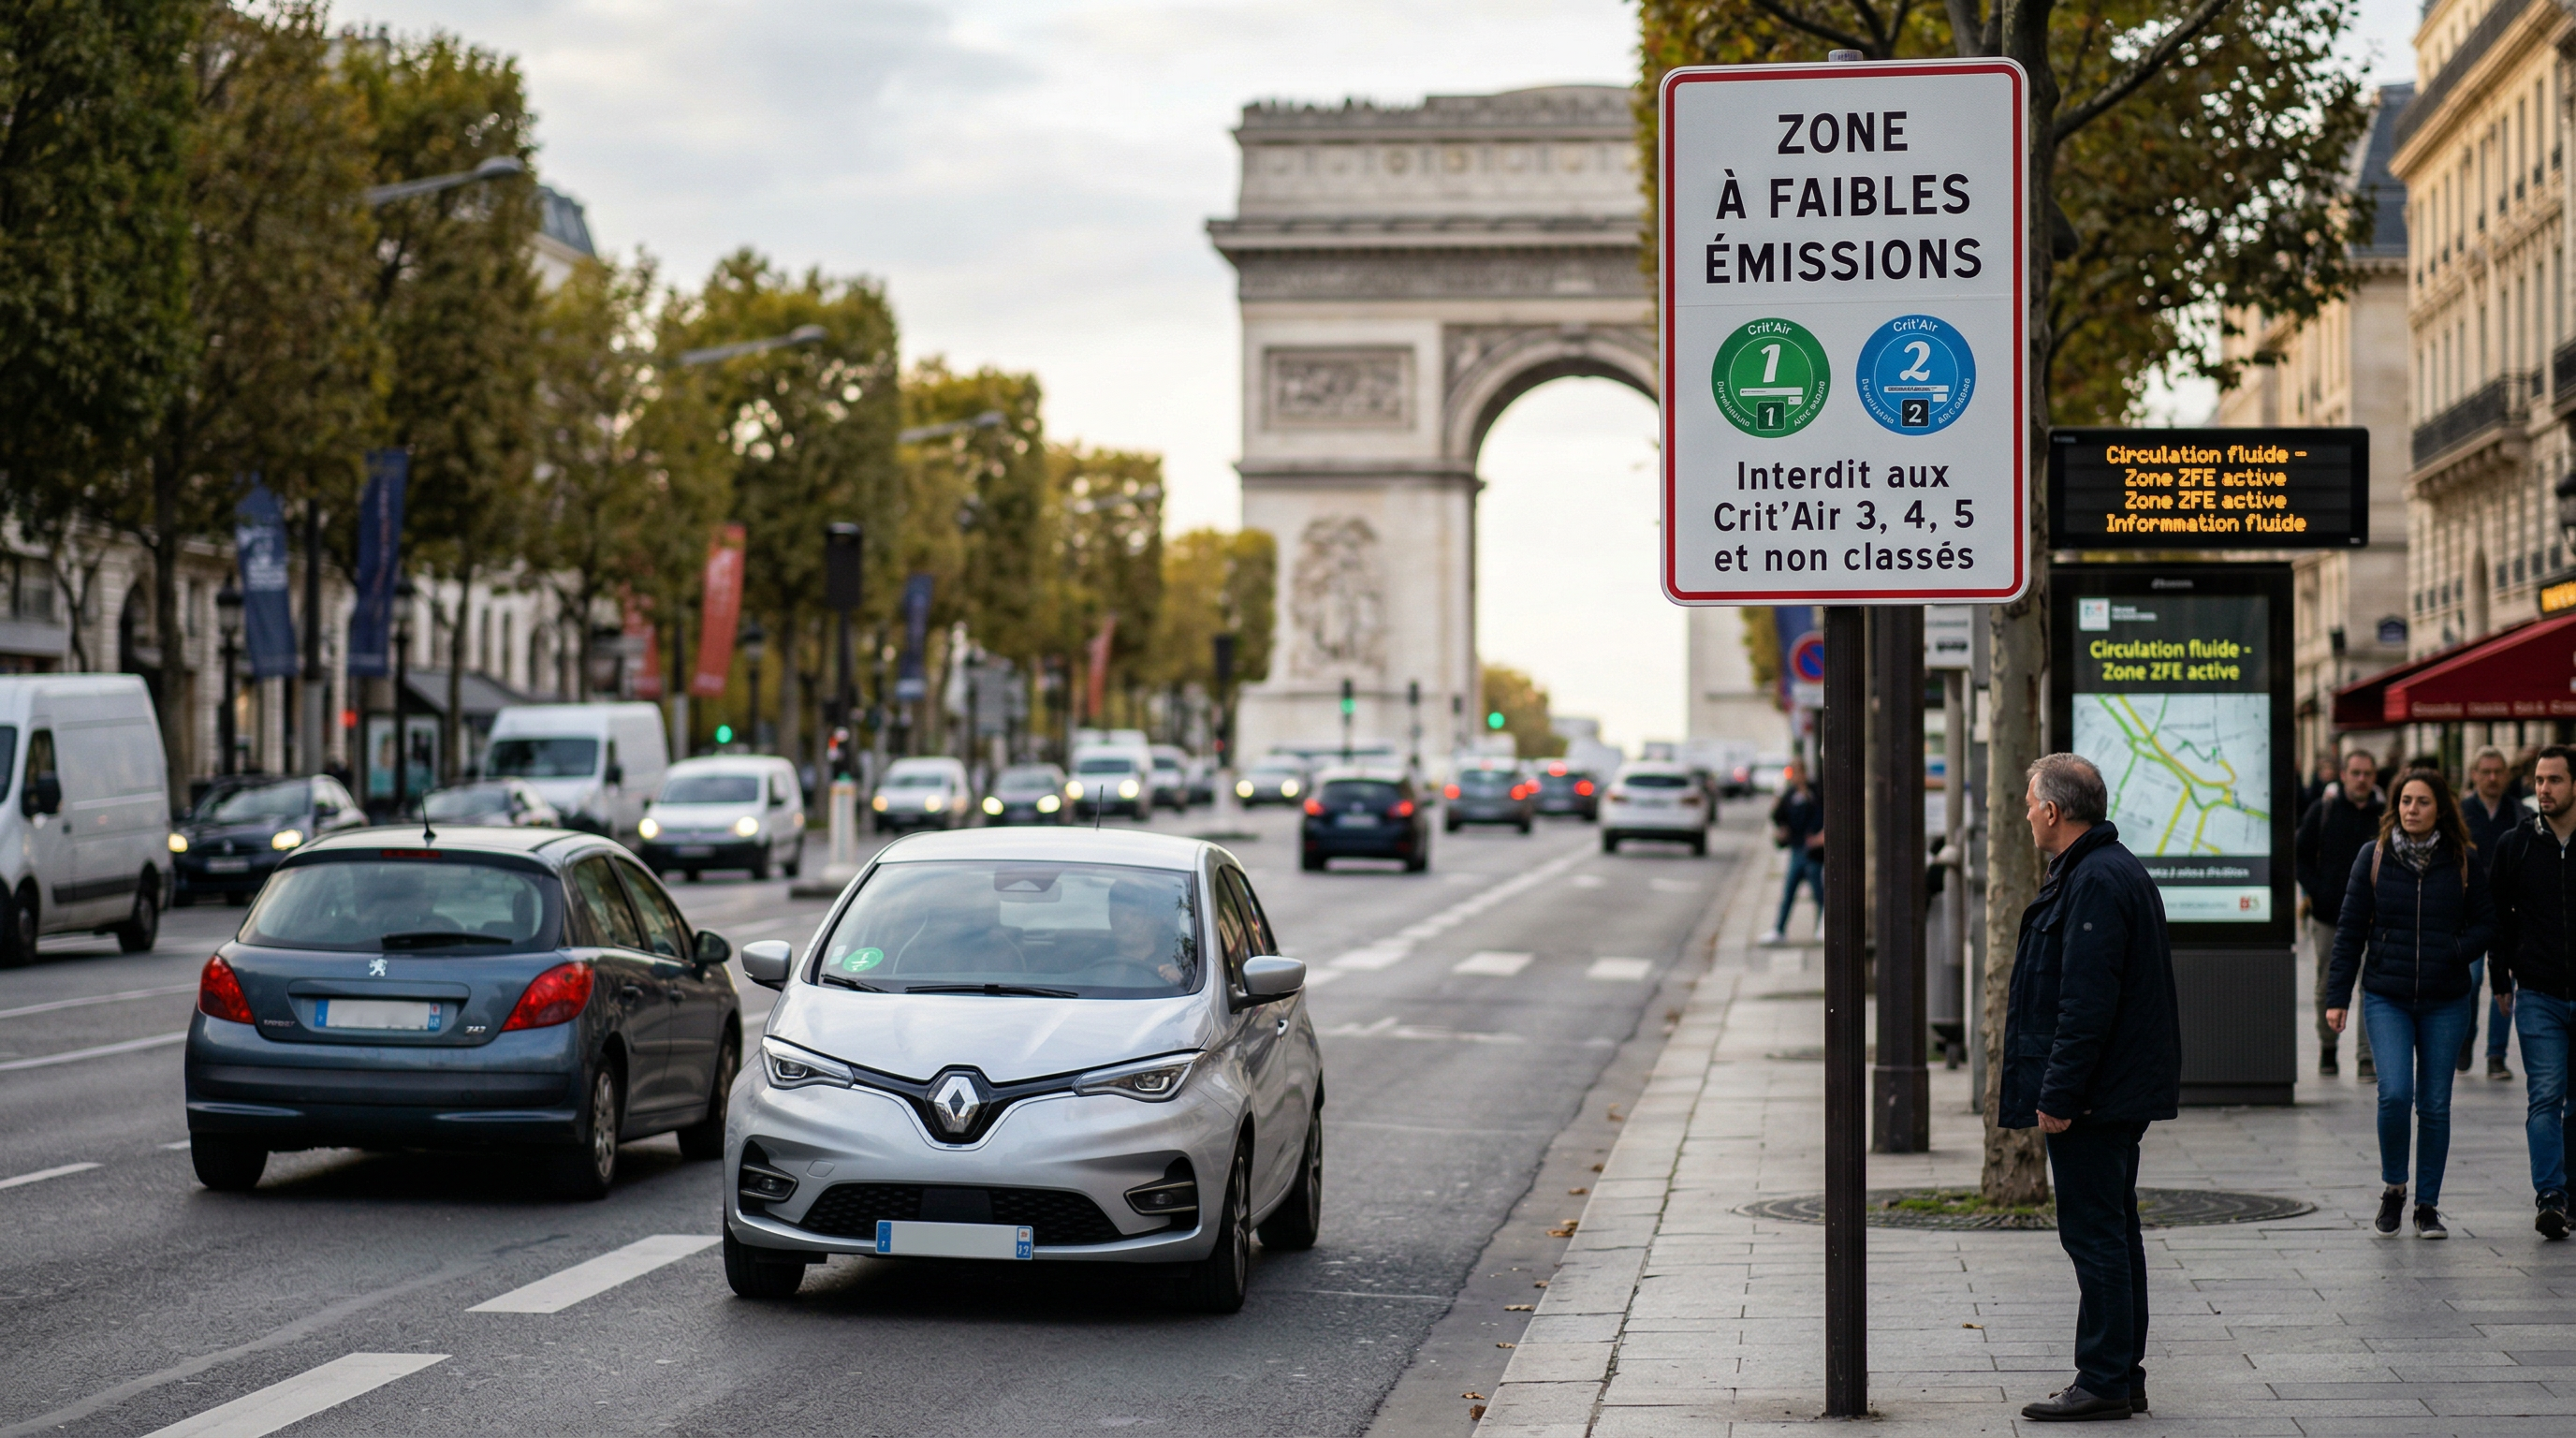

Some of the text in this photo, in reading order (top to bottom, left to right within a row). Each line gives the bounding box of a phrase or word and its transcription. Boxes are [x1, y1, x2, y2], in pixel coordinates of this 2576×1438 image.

[1778, 110, 1909, 154] ZONE
[1715, 169, 1970, 220] À FAIBLES
[1705, 232, 1982, 284] ÉMISSIONS
[1748, 322, 1792, 335] Crit'Air
[1761, 344, 1781, 383] 1
[1899, 341, 1931, 382] 2
[1765, 406, 1775, 427] 1
[1909, 404, 1922, 423] 2
[2105, 445, 2222, 464] Circulation
[2227, 445, 2289, 464] fluide
[1738, 459, 1950, 491] Interdit aux
[2125, 467, 2287, 488] Zone ZFE active
[2125, 490, 2287, 510] Zone ZFE active
[1714, 499, 1974, 535] Crit'Air 3, 4, 5
[2245, 513, 2307, 533] fluide
[1714, 540, 1974, 572] et non classés
[2089, 639, 2185, 660] Circulation
[2188, 638, 2240, 659] fluide
[2101, 662, 2241, 682] Zone ZFE active
